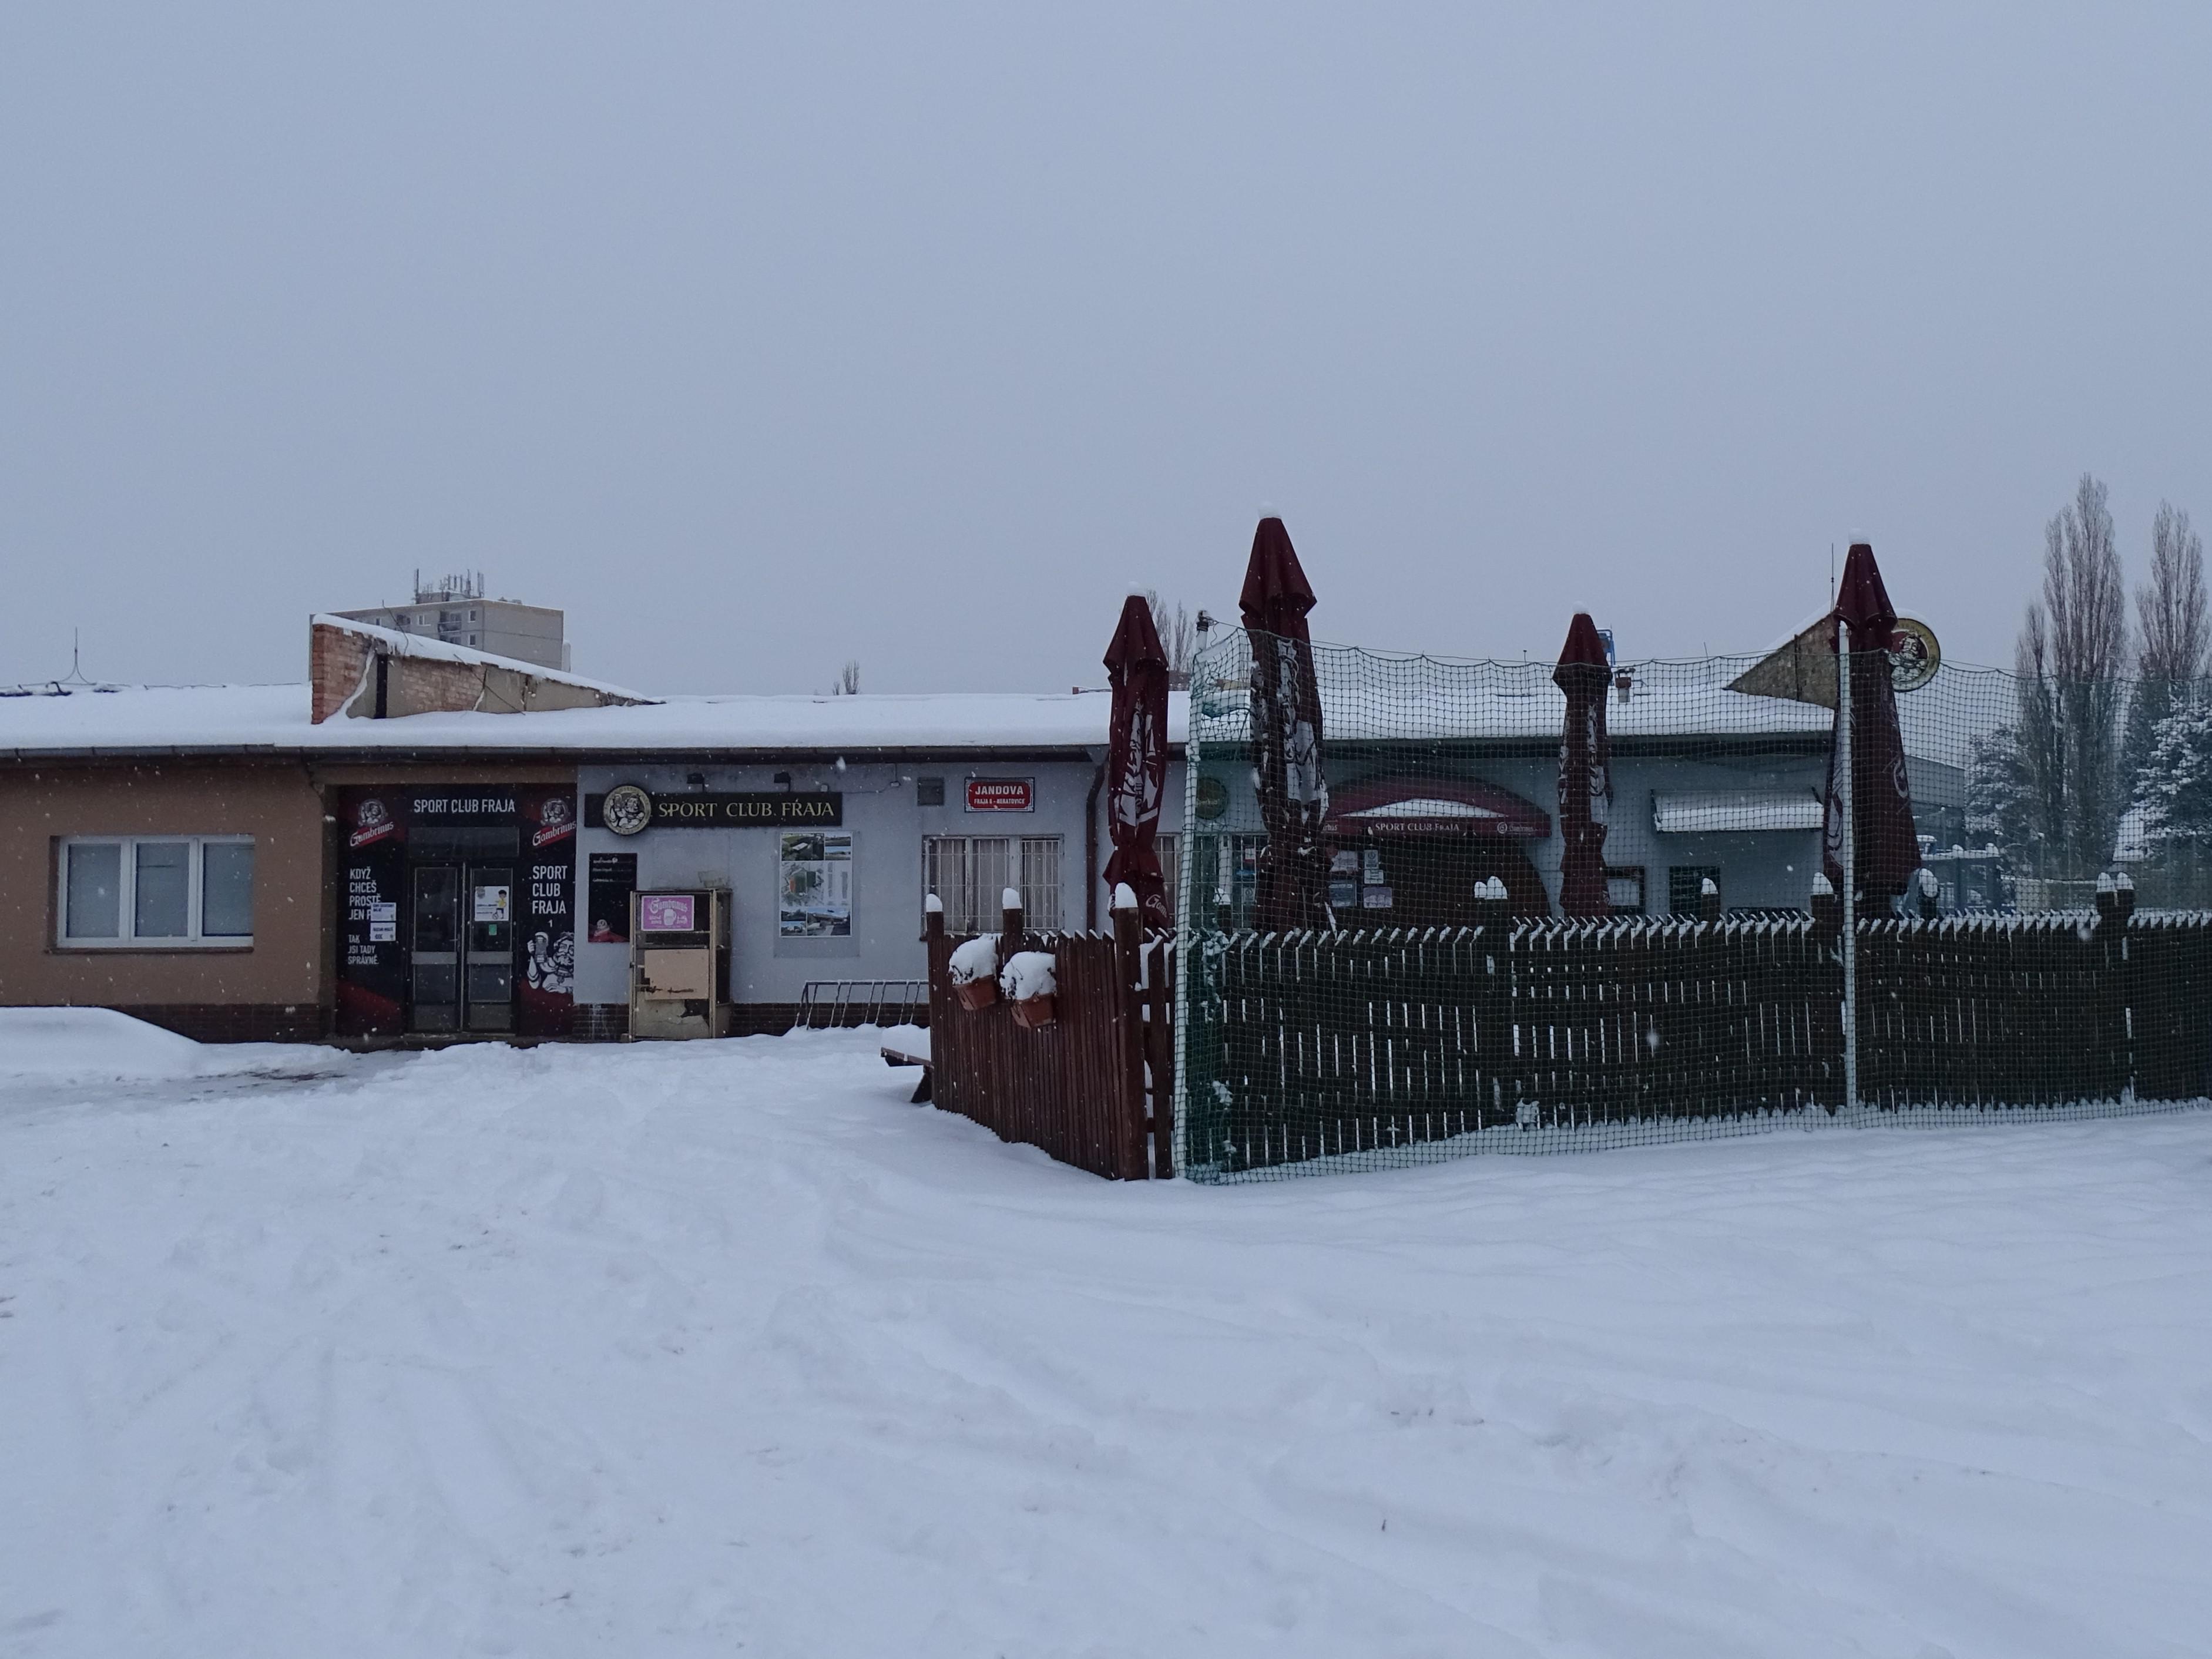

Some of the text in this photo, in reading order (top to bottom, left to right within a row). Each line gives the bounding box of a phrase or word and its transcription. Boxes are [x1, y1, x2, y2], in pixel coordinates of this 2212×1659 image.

[975, 785, 1024, 795] JANDOVA
[414, 799, 516, 813] SPORT CLUB FRAJA
[659, 802, 835, 817] SPORT CLUB FRAJA
[532, 821, 577, 846] Gambrinus
[1375, 822, 1405, 831] SPORT
[1407, 822, 1432, 831] CLUB
[350, 821, 394, 847] Gambrinus
[350, 866, 371, 879] KDYŽ
[532, 865, 568, 879] SPORT
[349, 879, 377, 893] CHCEŠ
[532, 882, 560, 896] CLUB
[349, 892, 381, 906] PROSTĚ
[532, 900, 567, 914] FRAJA
[348, 909, 365, 921] JEN
[348, 934, 361, 943] TAK
[348, 945, 376, 954] JSI TADY
